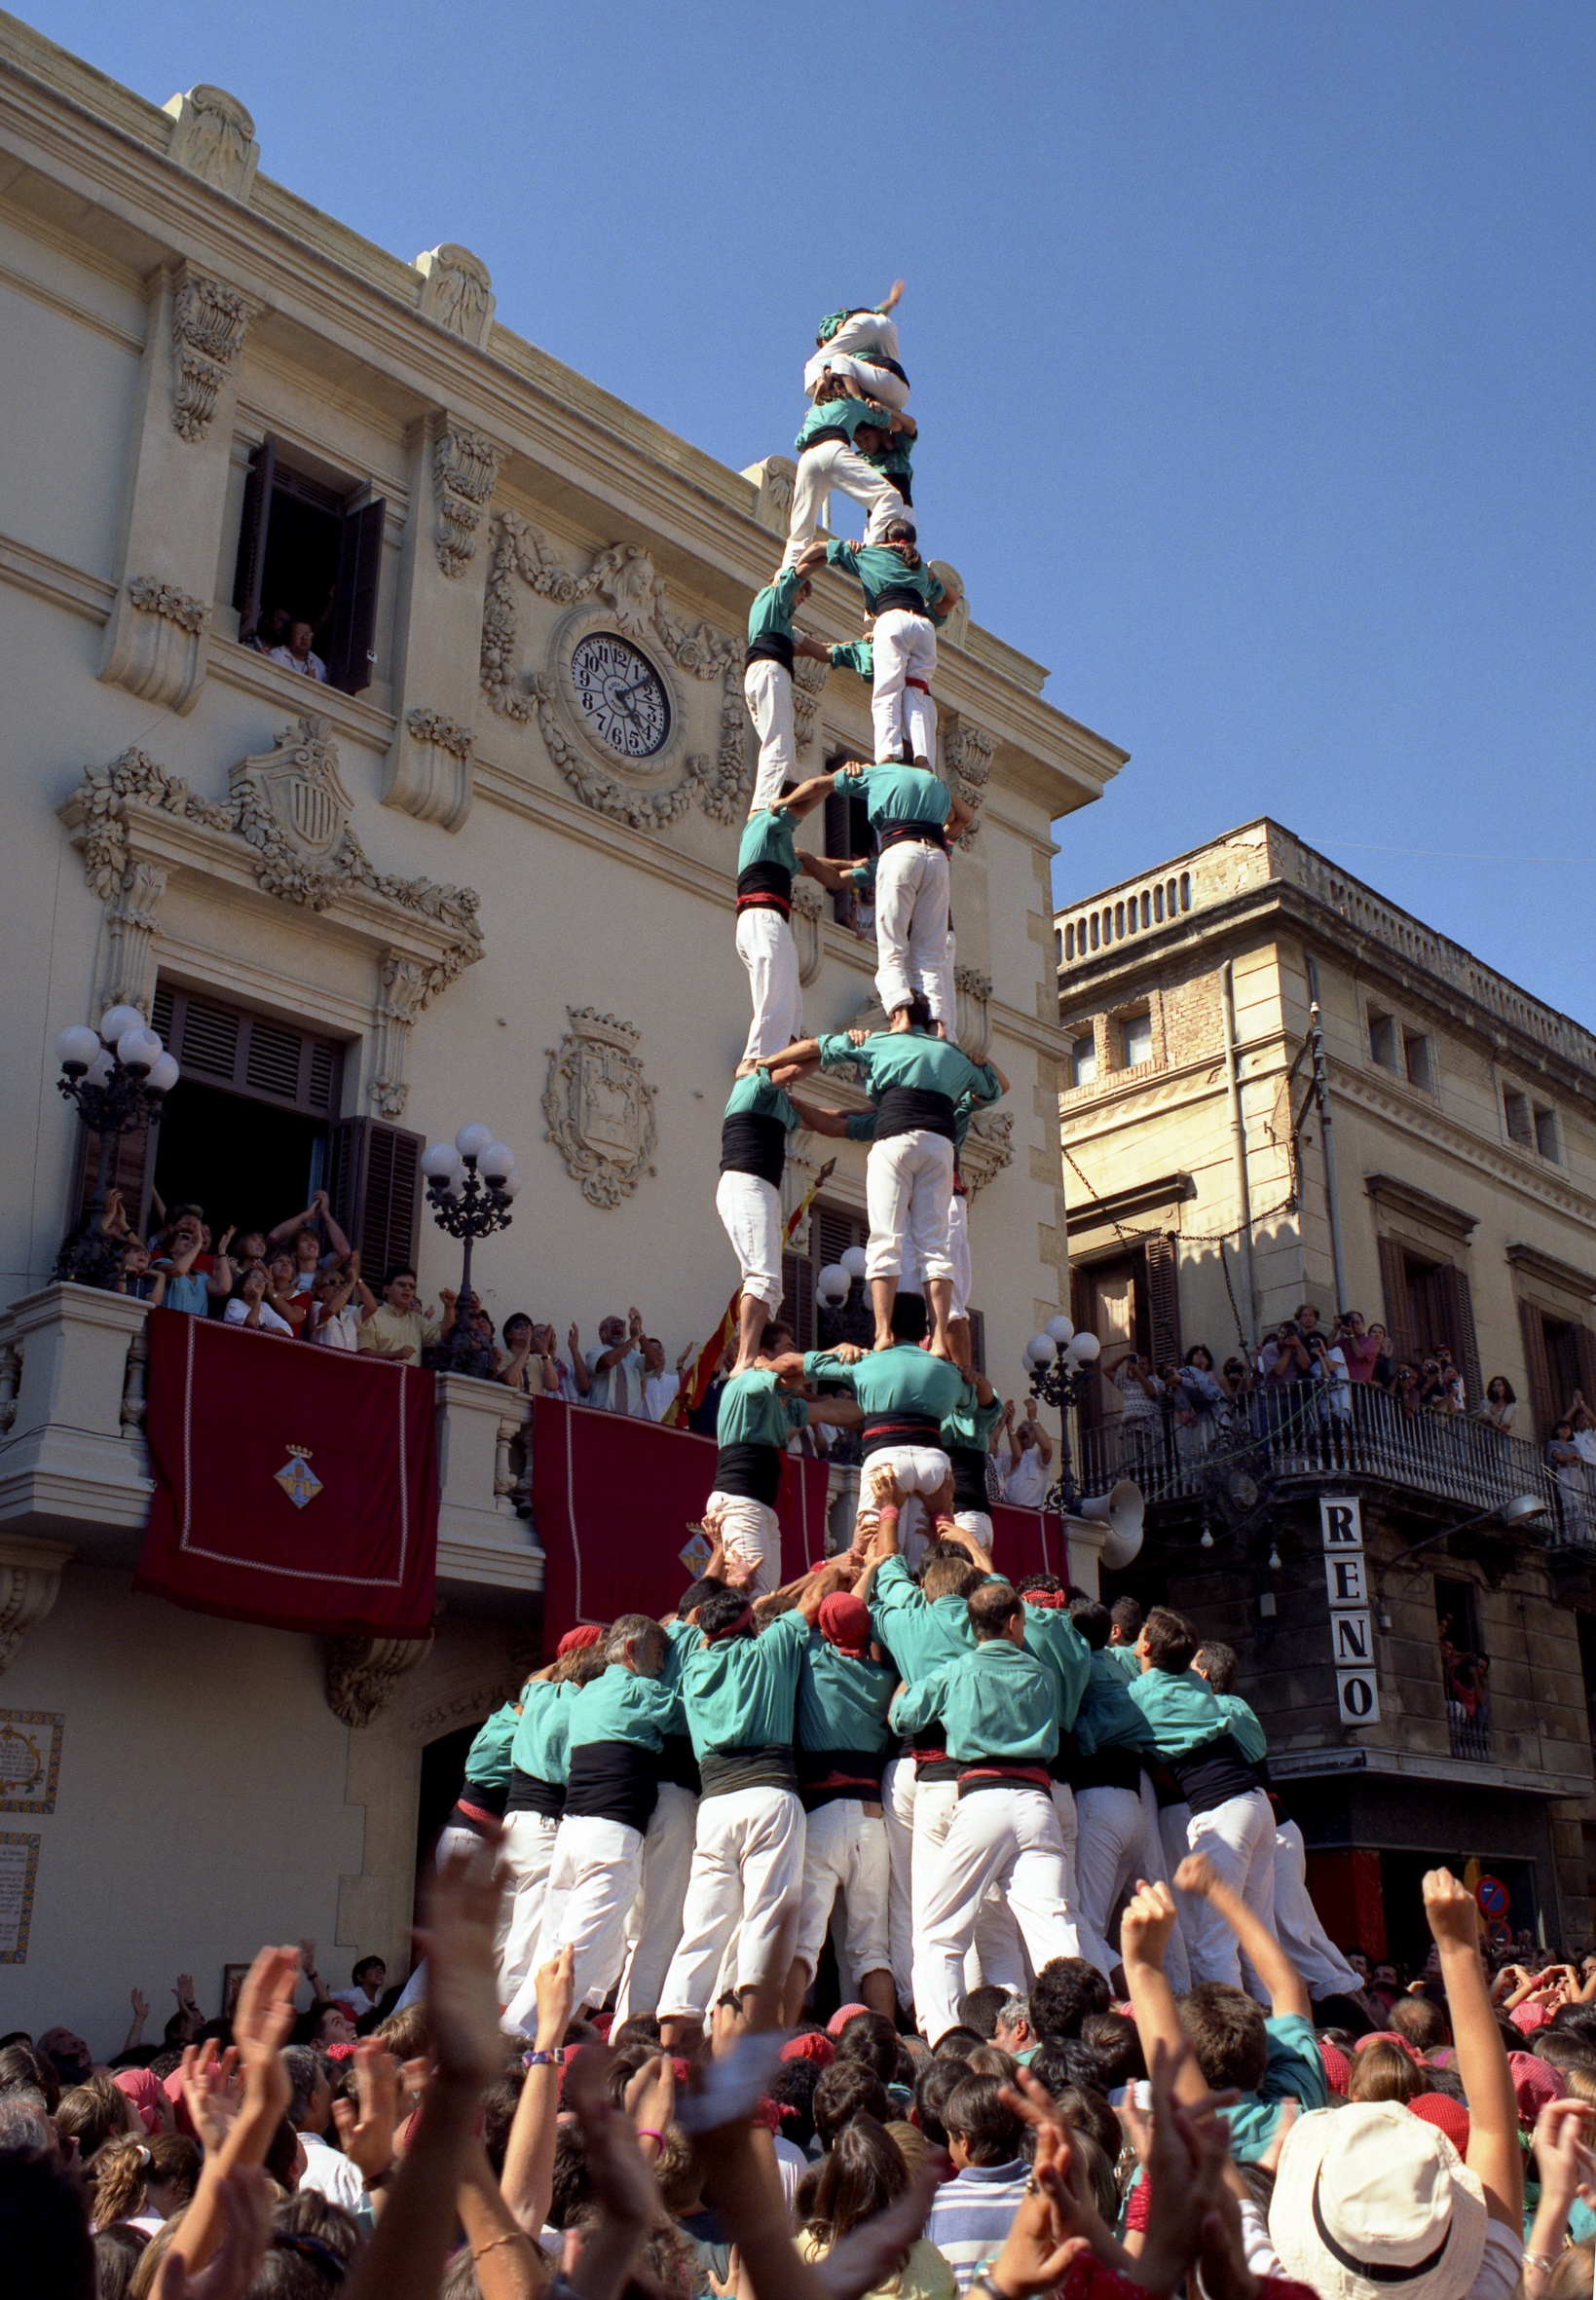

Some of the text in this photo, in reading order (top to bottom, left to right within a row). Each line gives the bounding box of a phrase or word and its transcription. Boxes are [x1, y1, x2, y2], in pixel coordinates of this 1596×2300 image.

[584, 652, 599, 672] 10
[598, 645, 609, 664] 11
[613, 648, 627, 668] 12
[579, 670, 590, 687] 9
[582, 691, 593, 710] 8
[643, 684, 652, 701] 2
[596, 713, 607, 731] 7
[648, 705, 656, 723] 3
[612, 727, 622, 745] 6
[629, 730, 639, 748] 5
[642, 724, 651, 741] 4
[1325, 1505, 1373, 1717] RENO
